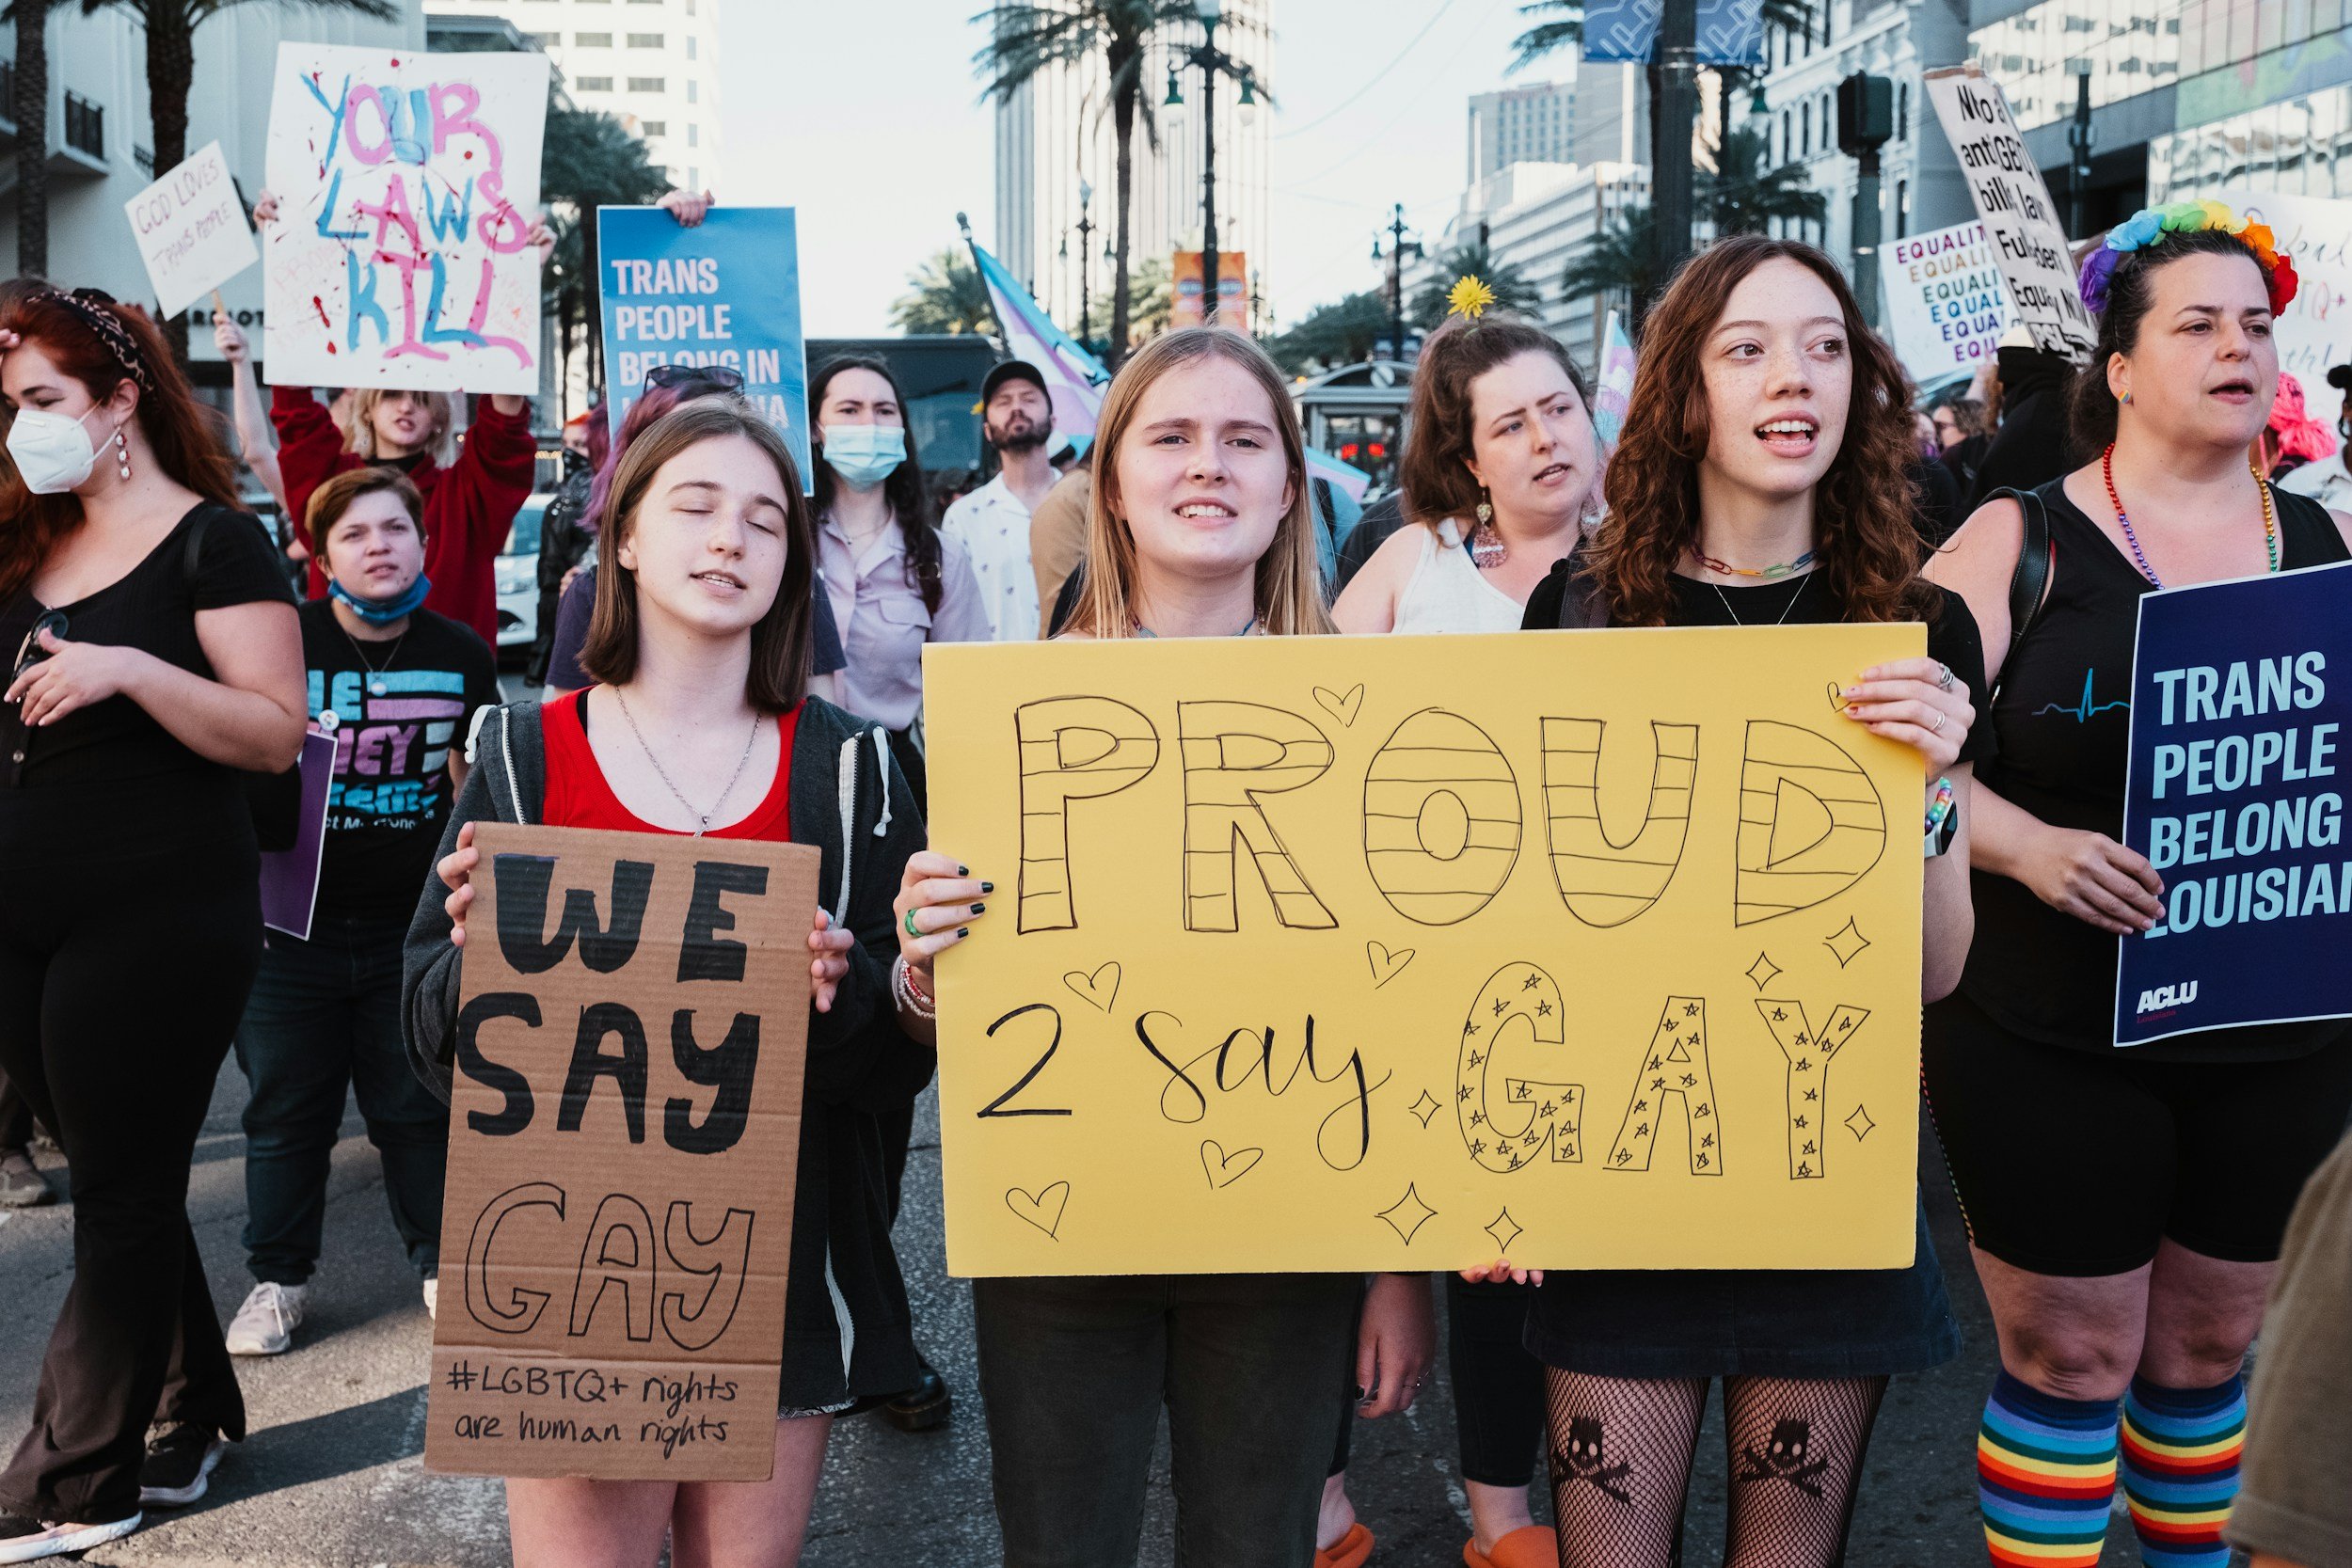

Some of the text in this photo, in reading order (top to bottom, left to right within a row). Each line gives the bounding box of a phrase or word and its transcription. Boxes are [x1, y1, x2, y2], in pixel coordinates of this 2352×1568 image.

[300, 72, 501, 170] YOUR
[135, 158, 219, 234] GOD LOVES
[315, 166, 529, 254] LAWS
[152, 200, 231, 276] TRANS PEOPLE
[346, 249, 533, 369] KILL
[612, 258, 719, 295] TRANS
[615, 304, 732, 341] PEOPLE
[1942, 309, 2005, 341] EQUA
[1954, 334, 2004, 362] EQU
[747, 349, 780, 384] IN
[2153, 651, 2326, 726] TRANS
[2152, 722, 2340, 800] PEOPLE
[1014, 695, 1887, 935] PROUD
[2150, 792, 2343, 870] BELONG
[493, 853, 770, 983] WE
[2137, 980, 2198, 1014] ACLU
[455, 991, 760, 1154] SAY
[977, 960, 1872, 1180] 2 say GAY
[465, 1181, 755, 1351] GAY
[446, 1360, 739, 1418] #LGBTQ+ rights
[455, 1411, 729, 1460] are human rights
